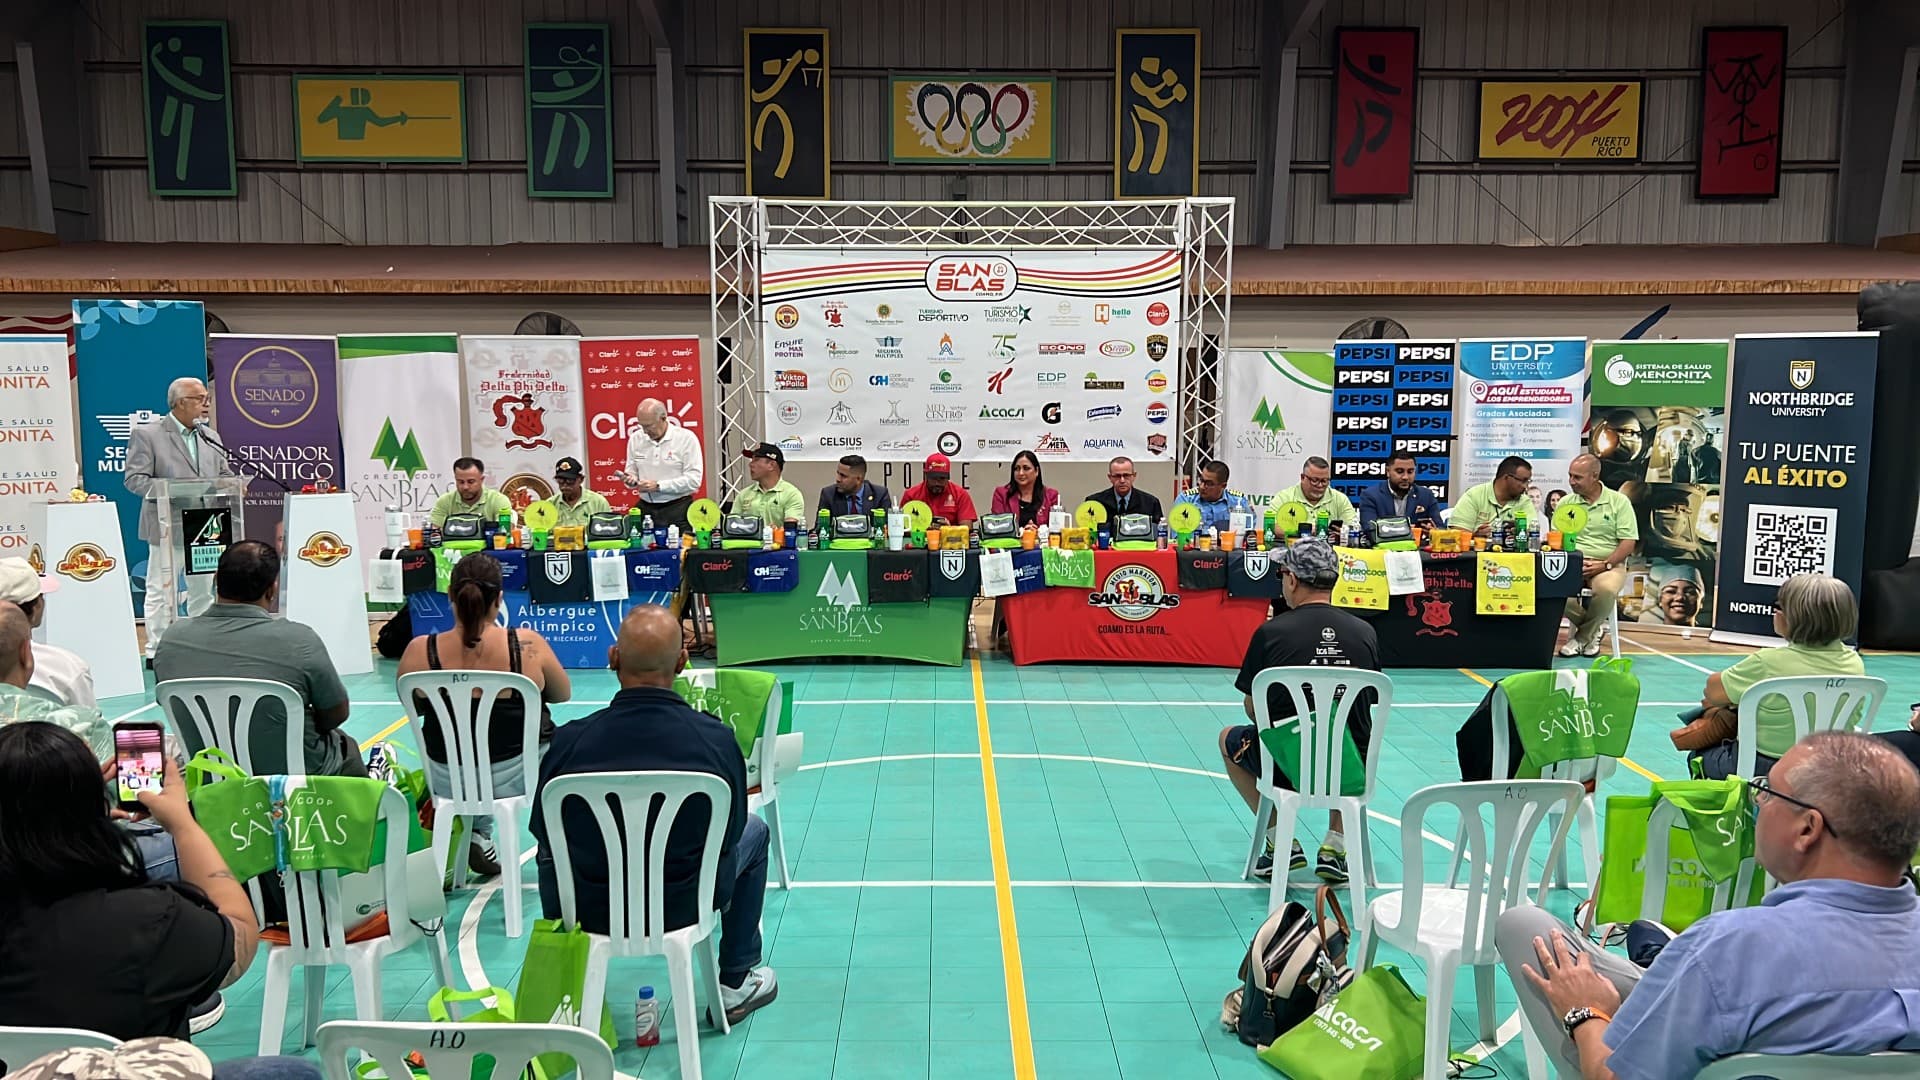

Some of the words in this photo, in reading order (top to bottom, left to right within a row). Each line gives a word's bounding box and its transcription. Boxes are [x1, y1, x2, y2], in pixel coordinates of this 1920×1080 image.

[1495, 85, 1629, 157] 2004
[1591, 136, 1631, 147] PUERTO
[1596, 146, 1623, 156] RICO
[938, 262, 992, 276] SAN
[936, 278, 1005, 291] BLAS
[984, 310, 1018, 318] TURISMO
[774, 338, 804, 349] Ensure
[1340, 348, 1390, 359] PEPSI
[1400, 347, 1450, 360] PEPSI
[1491, 344, 1554, 360] EDP
[1492, 362, 1552, 370] UNIVERSITY
[1038, 372, 1066, 381] EDP
[1338, 371, 1390, 384] PEPSI
[1399, 371, 1449, 382] PEPSI
[1634, 371, 1712, 379] MENONITA
[1796, 370, 1807, 381] N
[514, 381, 533, 394] Phi
[1489, 385, 1520, 395] AQUÍ
[245, 388, 306, 402] SENADO
[1338, 394, 1388, 406] PEPSI
[1397, 393, 1448, 406] PEPSI
[1749, 392, 1854, 406] NORTHBRIDGE
[1772, 408, 1827, 417] UNIVERSITY
[1336, 416, 1388, 430] PEPSI
[1397, 417, 1447, 429] PEPSI
[820, 437, 862, 446] CELSIUS
[1084, 439, 1124, 449] AQUAFINA
[1336, 440, 1386, 452] PEPSI
[1396, 440, 1446, 452] PEPSI
[239, 446, 332, 461] SENADOR
[1739, 442, 1766, 460] TU
[1774, 443, 1856, 463] PUENTE
[1335, 462, 1386, 475] PEPSI
[1744, 467, 1772, 485] AL
[1777, 465, 1848, 488] ÉXITO
[553, 563, 564, 575] N
[702, 561, 731, 571] Claro
[948, 560, 957, 571] N
[1193, 558, 1222, 569] Claro
[1252, 560, 1262, 571] N
[1550, 559, 1559, 570] N
[883, 570, 912, 580] Claro
[1110, 570, 1127, 586] MEDIO
[1089, 594, 1122, 605] SAN
[1139, 594, 1179, 606] BLAS
[518, 605, 597, 619] Albergue
[1729, 602, 1776, 616] NORTH
[1098, 625, 1124, 634] COAMO
[1125, 625, 1134, 634] ES
[1136, 625, 1144, 634] LA
